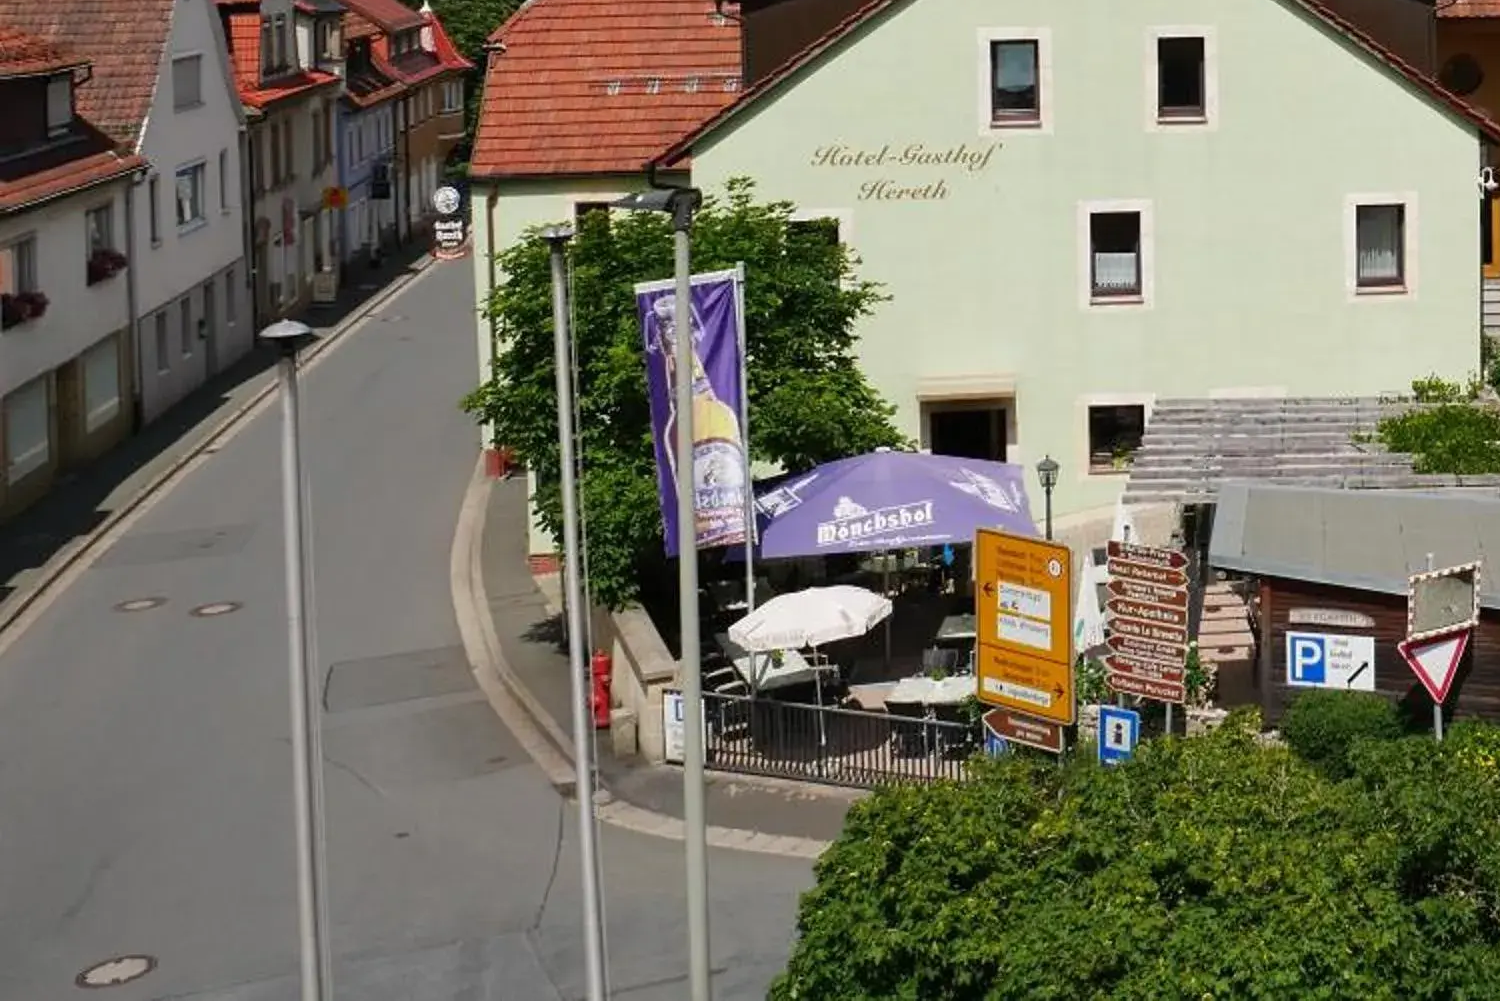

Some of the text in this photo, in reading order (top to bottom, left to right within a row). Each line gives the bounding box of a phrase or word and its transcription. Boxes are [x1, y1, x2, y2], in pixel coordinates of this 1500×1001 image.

[810, 142, 1003, 171] Hotel-Gasthof
[857, 178, 950, 201] Hereth
[817, 501, 934, 545] Mönchshof
[1295, 640, 1322, 679] P
